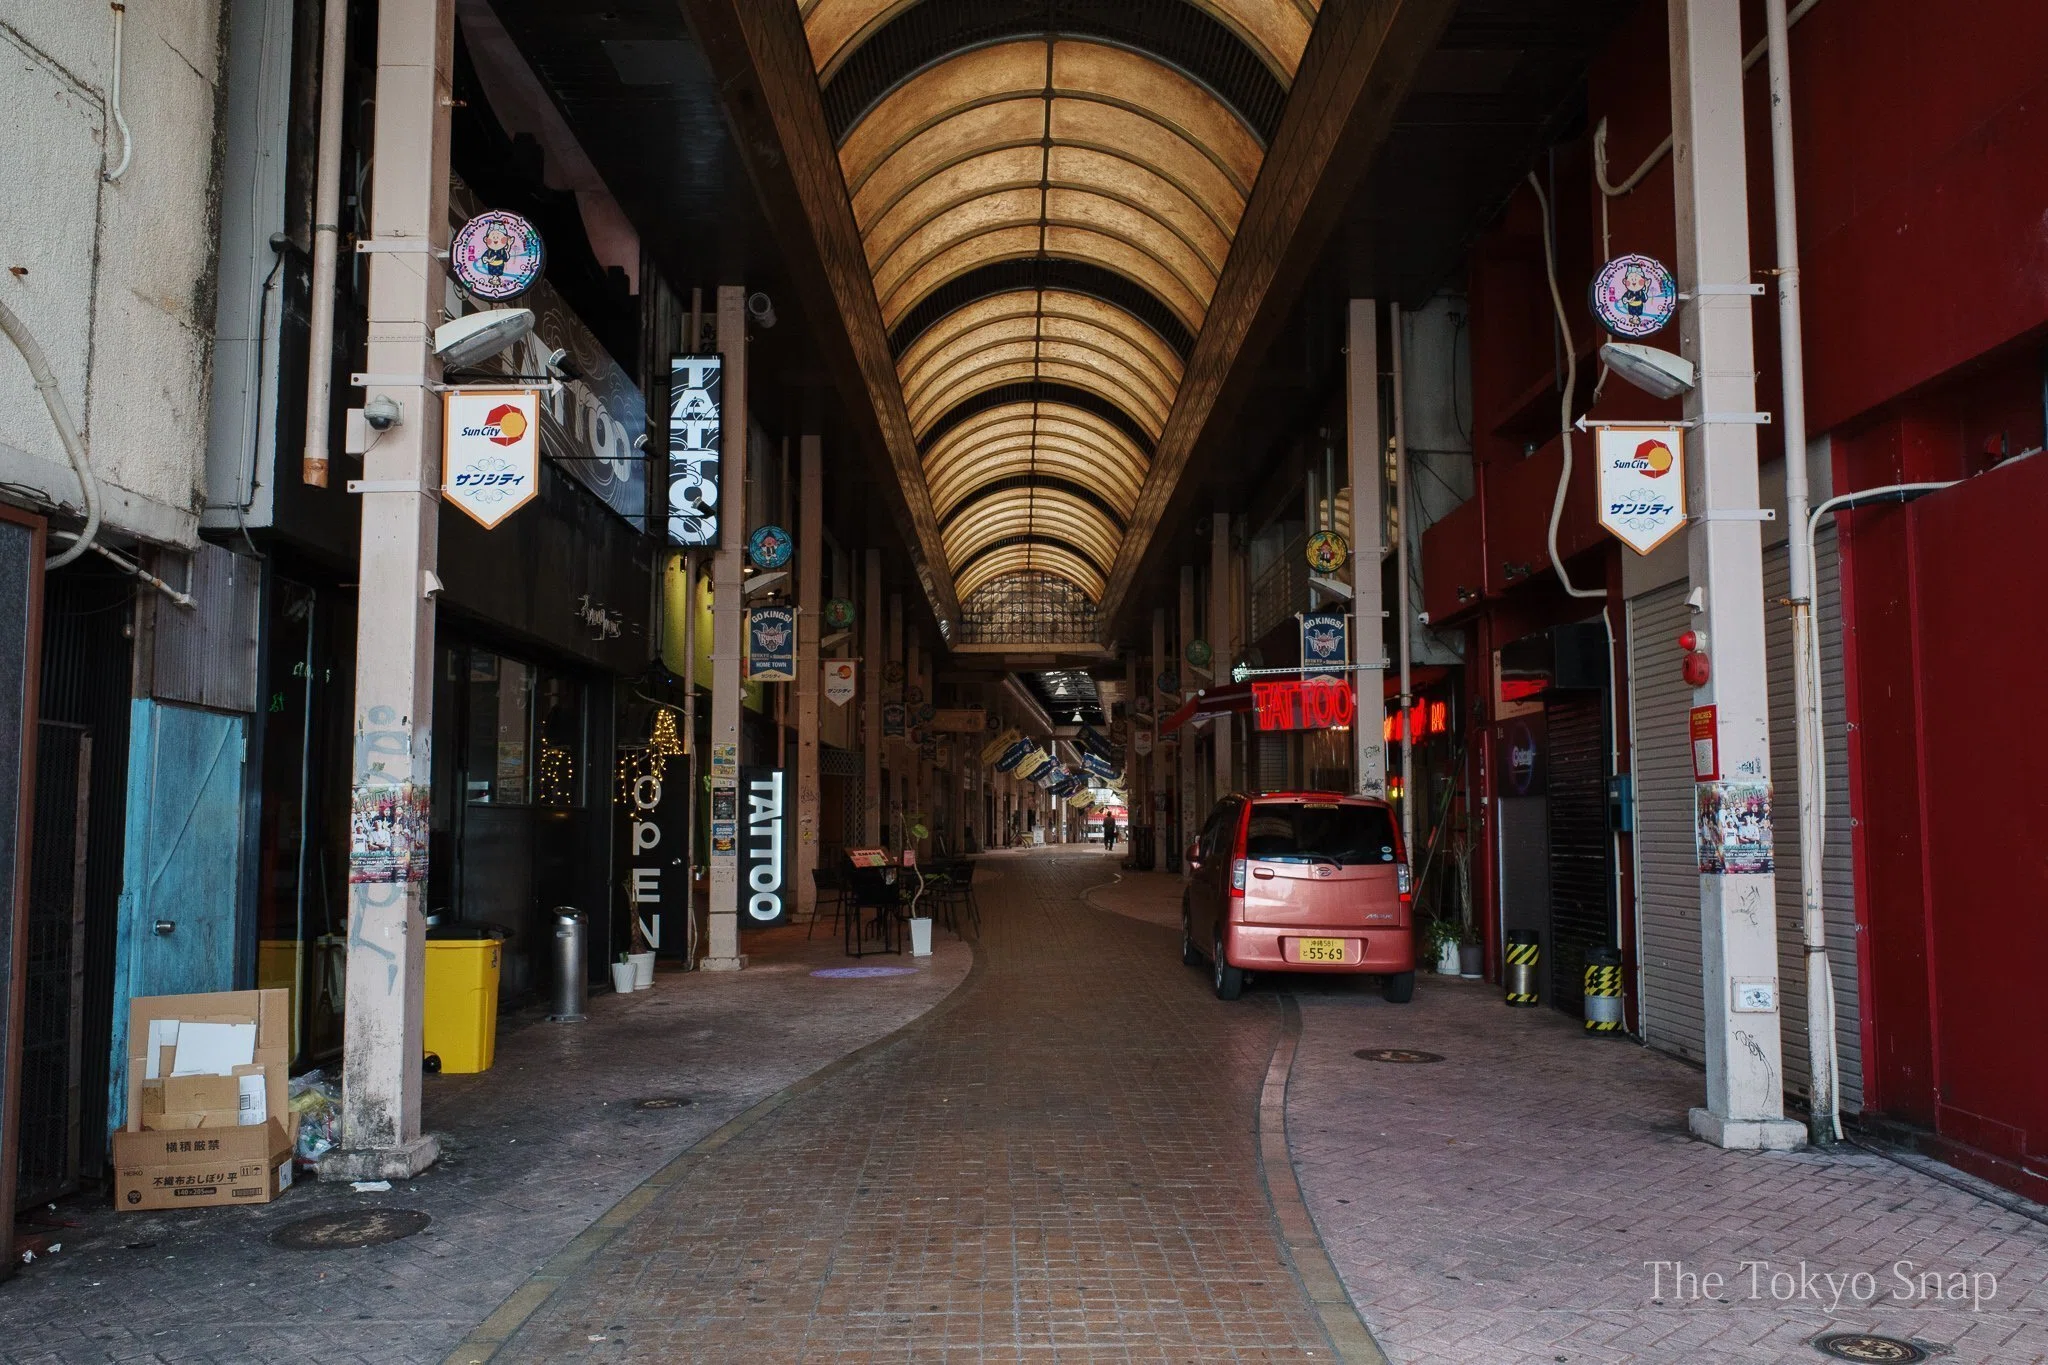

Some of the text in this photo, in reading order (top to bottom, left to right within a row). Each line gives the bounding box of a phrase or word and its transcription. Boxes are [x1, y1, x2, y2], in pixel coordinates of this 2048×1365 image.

[668, 359, 720, 542] TATTOO
[455, 473, 525, 486] サンシティ
[1610, 503, 1674, 515] サンシティ
[752, 610, 793, 623] GO KINGS!
[1304, 617, 1344, 629] GO KINGS!
[1252, 679, 1354, 731] TATTOO
[1431, 702, 1446, 732] BAR
[748, 771, 783, 920] TATTOO
[1309, 948, 1343, 960] 55-69
[166, 1139, 220, 1153] 横積厳禁
